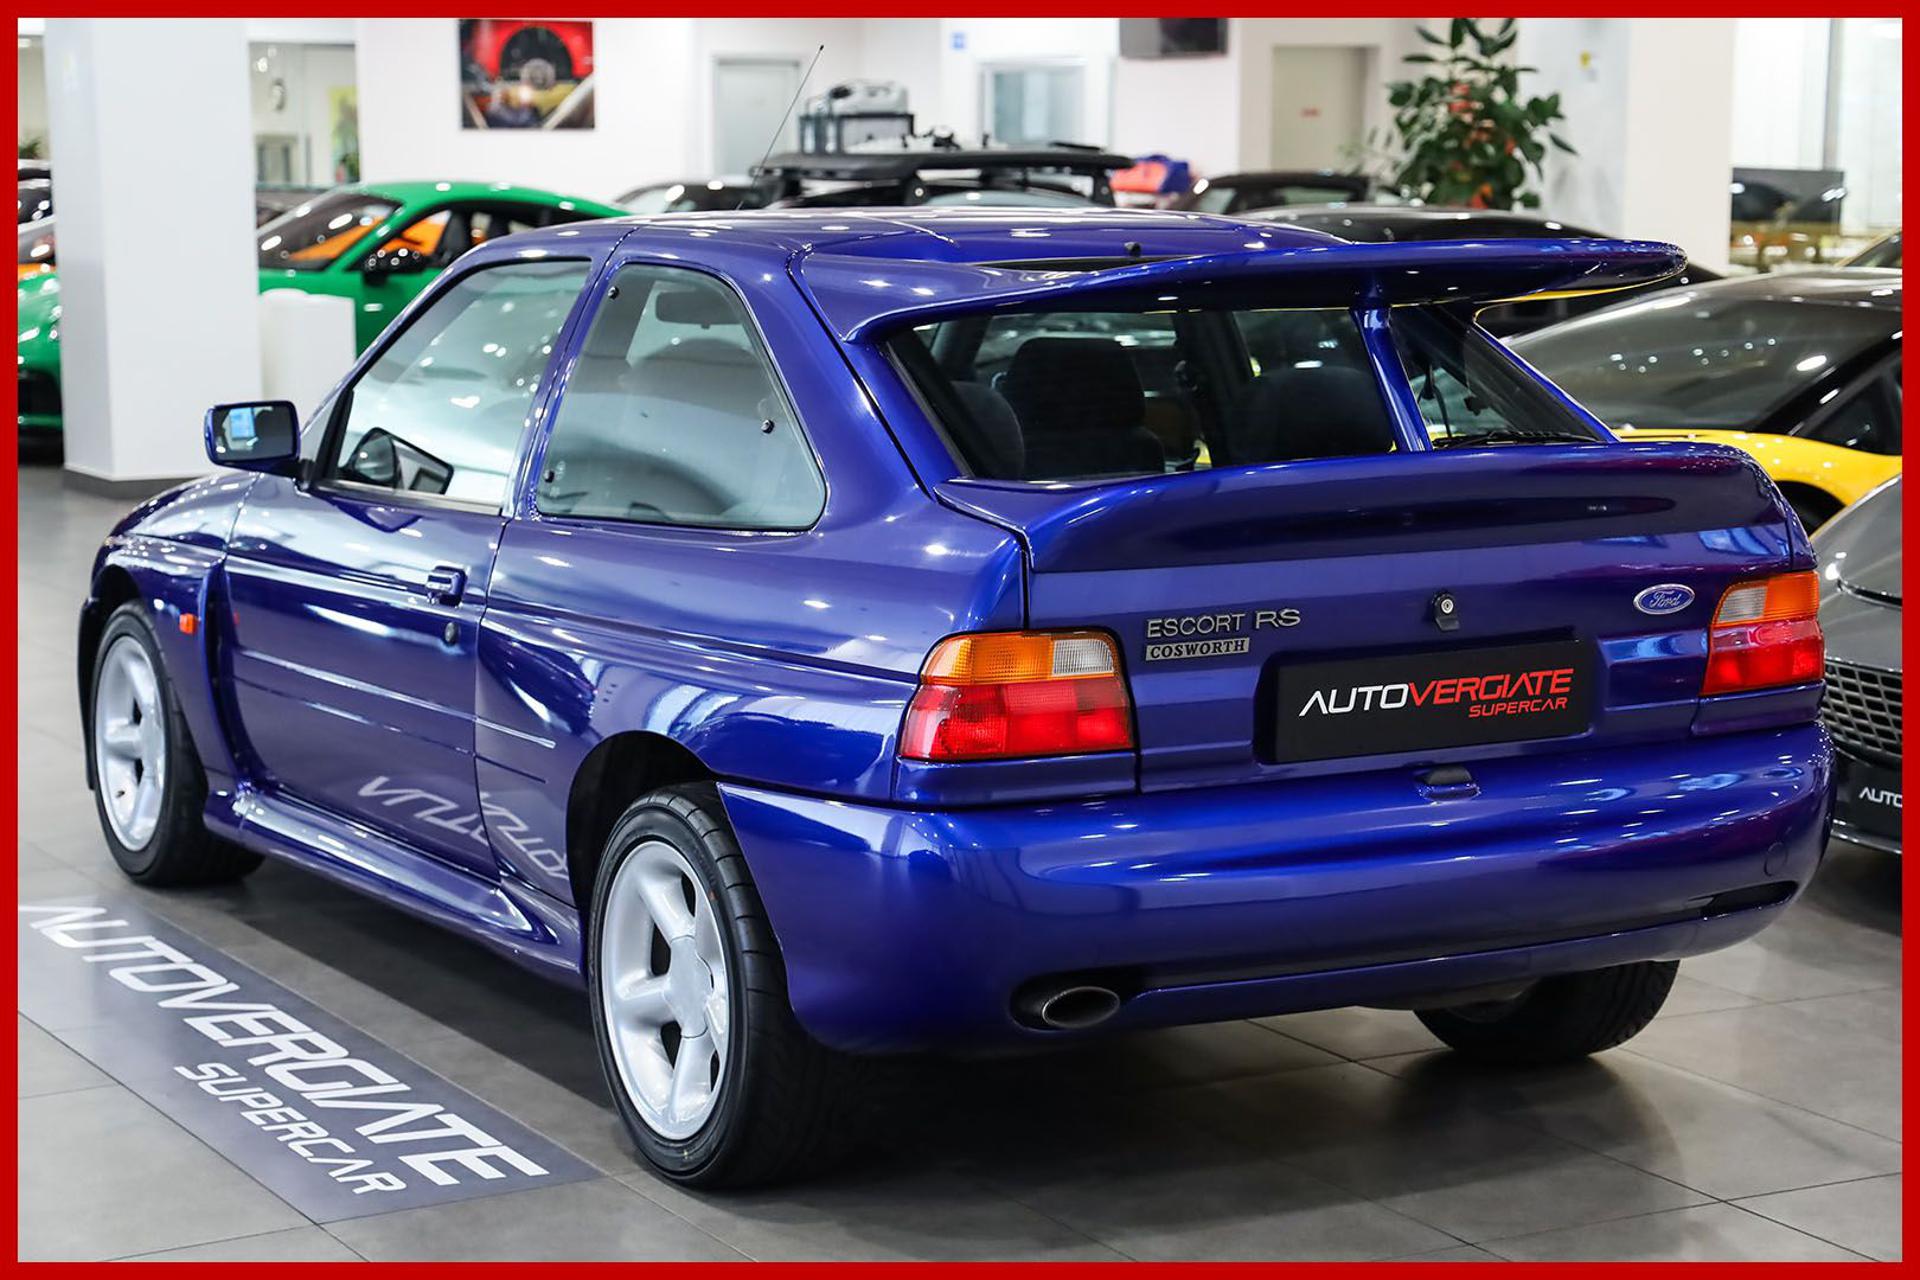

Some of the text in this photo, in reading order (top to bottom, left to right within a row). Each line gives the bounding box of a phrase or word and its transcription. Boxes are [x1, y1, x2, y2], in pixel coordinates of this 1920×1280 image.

[1649, 590, 1682, 608] Ford
[1147, 608, 1301, 638] ESCORT RS
[1150, 639, 1246, 659] COSWORTH
[1298, 668, 1574, 717] AUTOVERGIATE
[1468, 697, 1568, 718] SUPERCAR
[18, 905, 550, 1186] AUTOVERGIATE
[173, 1061, 407, 1195] SUPERCAR
